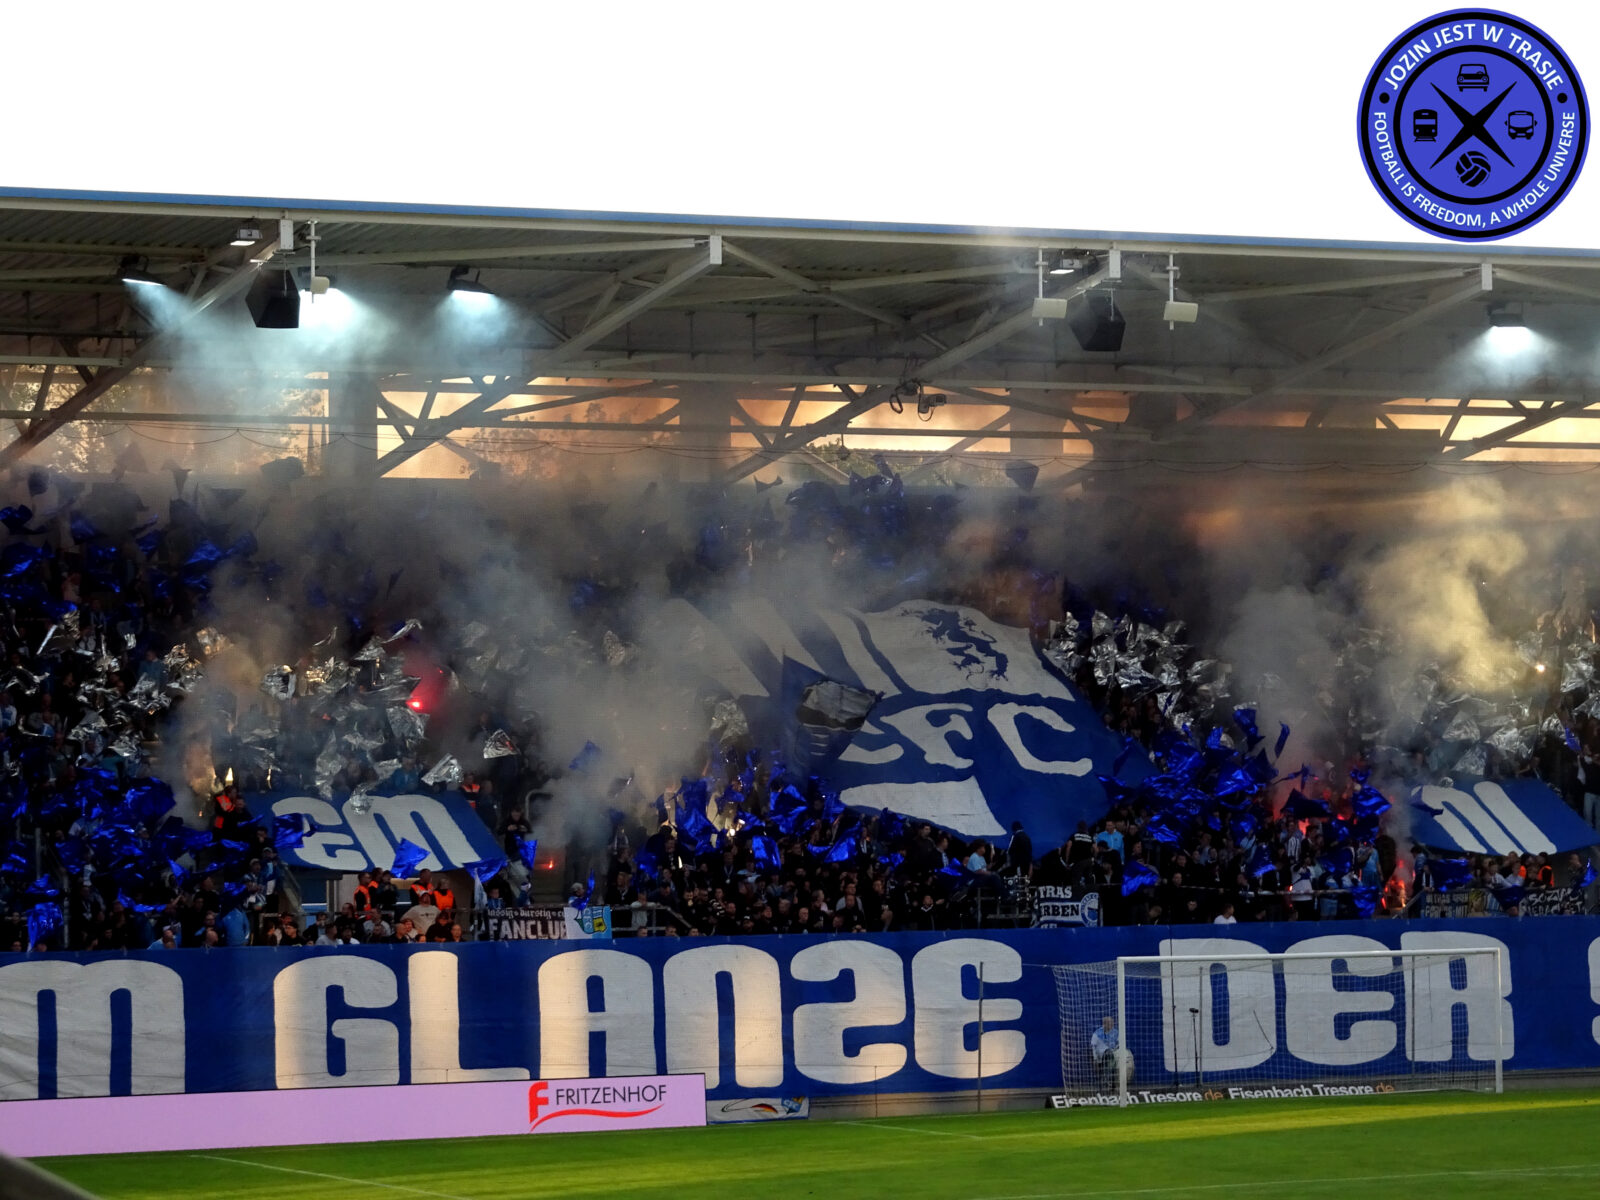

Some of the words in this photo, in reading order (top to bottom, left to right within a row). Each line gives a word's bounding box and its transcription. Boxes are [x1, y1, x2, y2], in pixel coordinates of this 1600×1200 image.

[274, 938, 1027, 1089] GLANZE
[1159, 931, 1514, 1072] DER
[555, 1085, 667, 1105] FRITZENHOF
[1052, 1092, 1139, 1109] Eisenbah
[1228, 1085, 1313, 1100] Eisenbach
